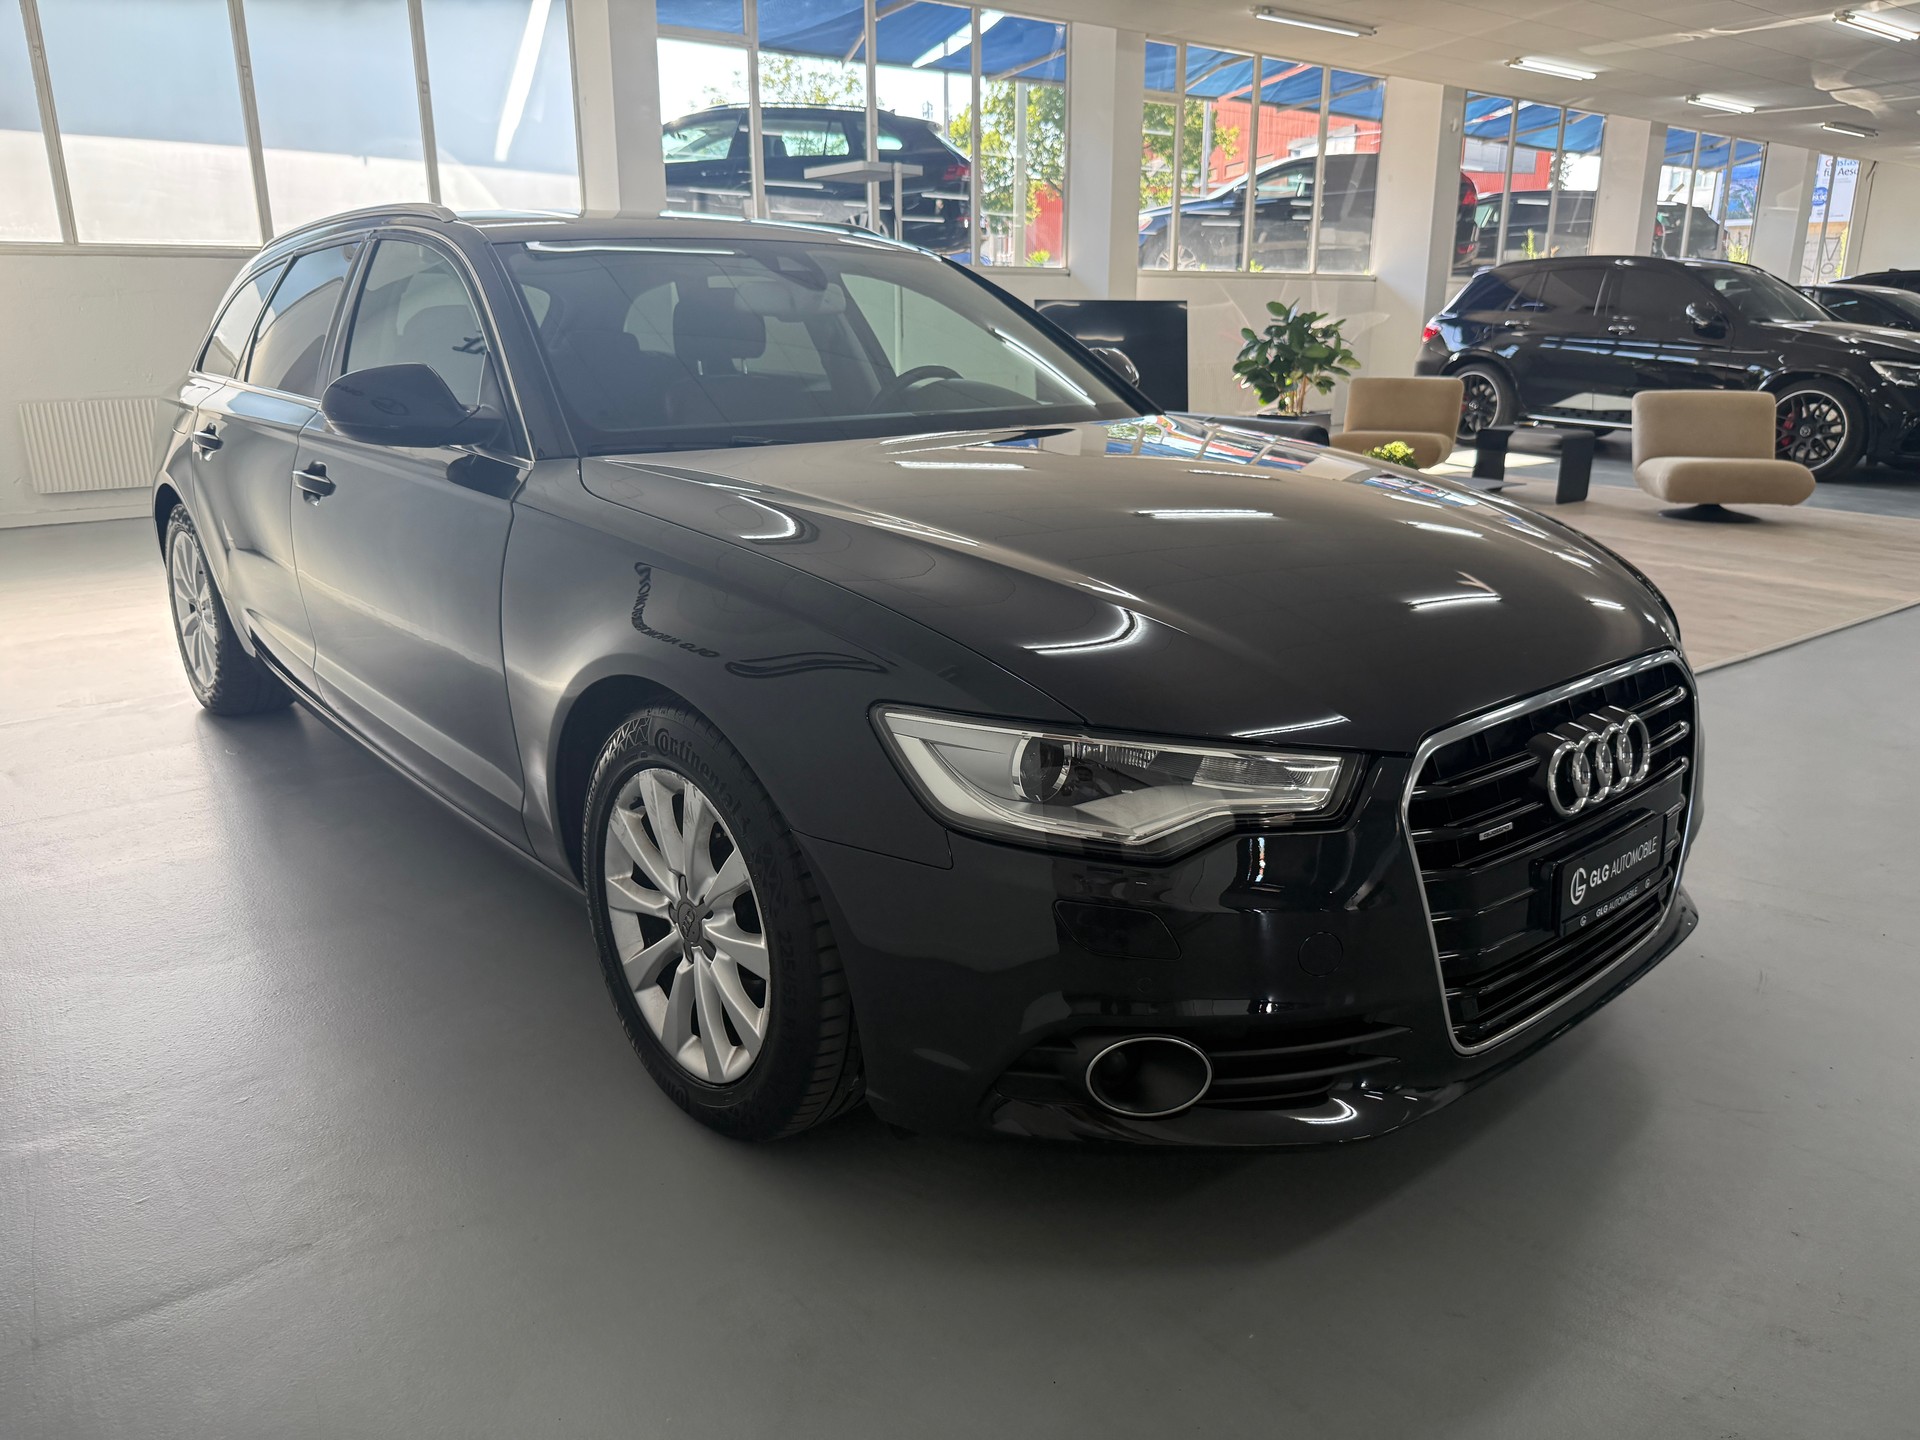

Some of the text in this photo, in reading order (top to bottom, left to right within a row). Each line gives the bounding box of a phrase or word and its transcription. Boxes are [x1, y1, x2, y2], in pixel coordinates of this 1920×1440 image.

[654, 727, 742, 815] Continental
[1483, 824, 1510, 838] quattro
[1589, 864, 1610, 888] GLG
[1610, 835, 1658, 878] AUTOMOBILE
[1595, 886, 1638, 918] GLG AUTOMOBILE
